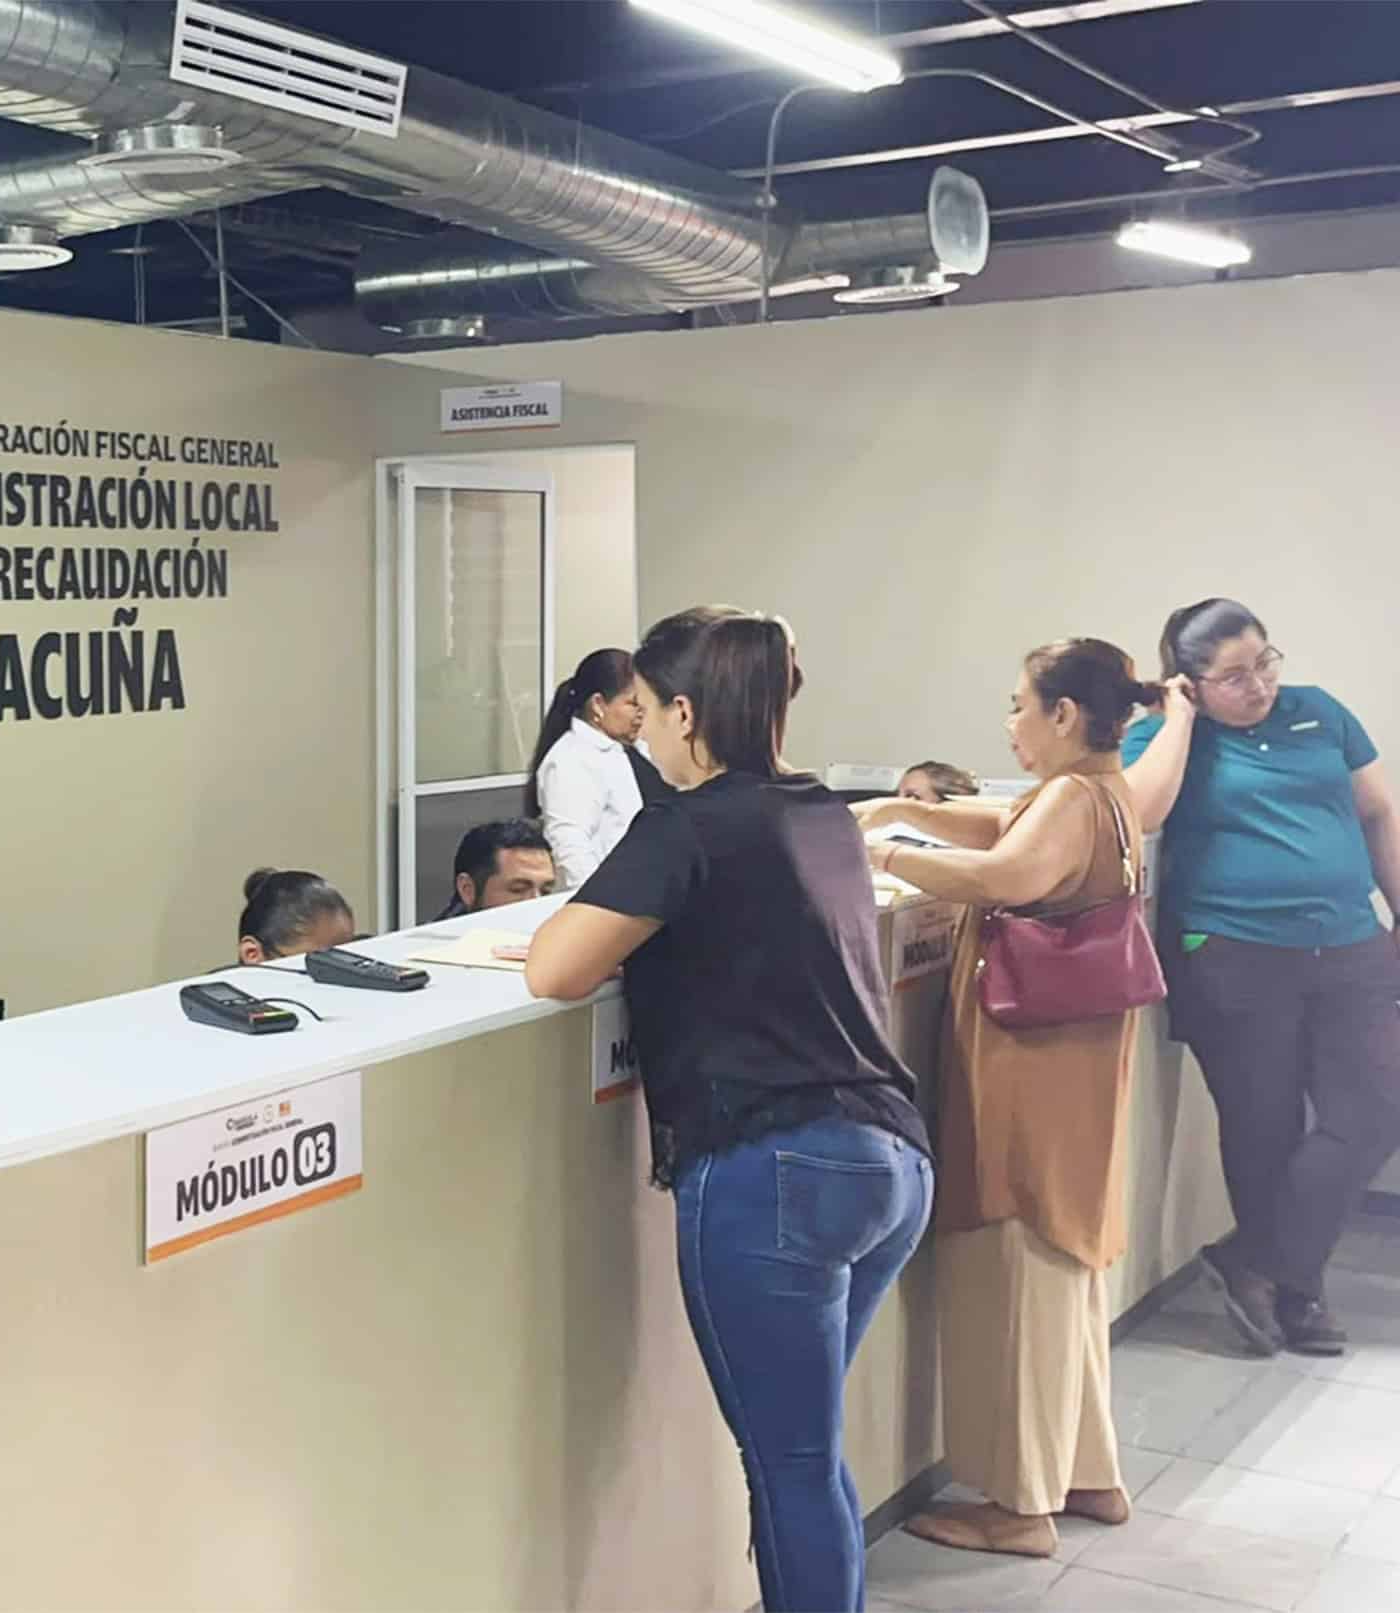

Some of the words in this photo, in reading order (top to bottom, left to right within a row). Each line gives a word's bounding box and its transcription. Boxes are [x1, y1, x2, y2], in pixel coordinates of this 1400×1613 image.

[513, 403, 548, 416] FISCAL
[95, 431, 175, 463] FISCAL
[181, 437, 279, 468] GENERAL
[184, 482, 279, 532] LOCAL
[176, 1148, 288, 1222] MÓDULO
[300, 1131, 331, 1179] 03
